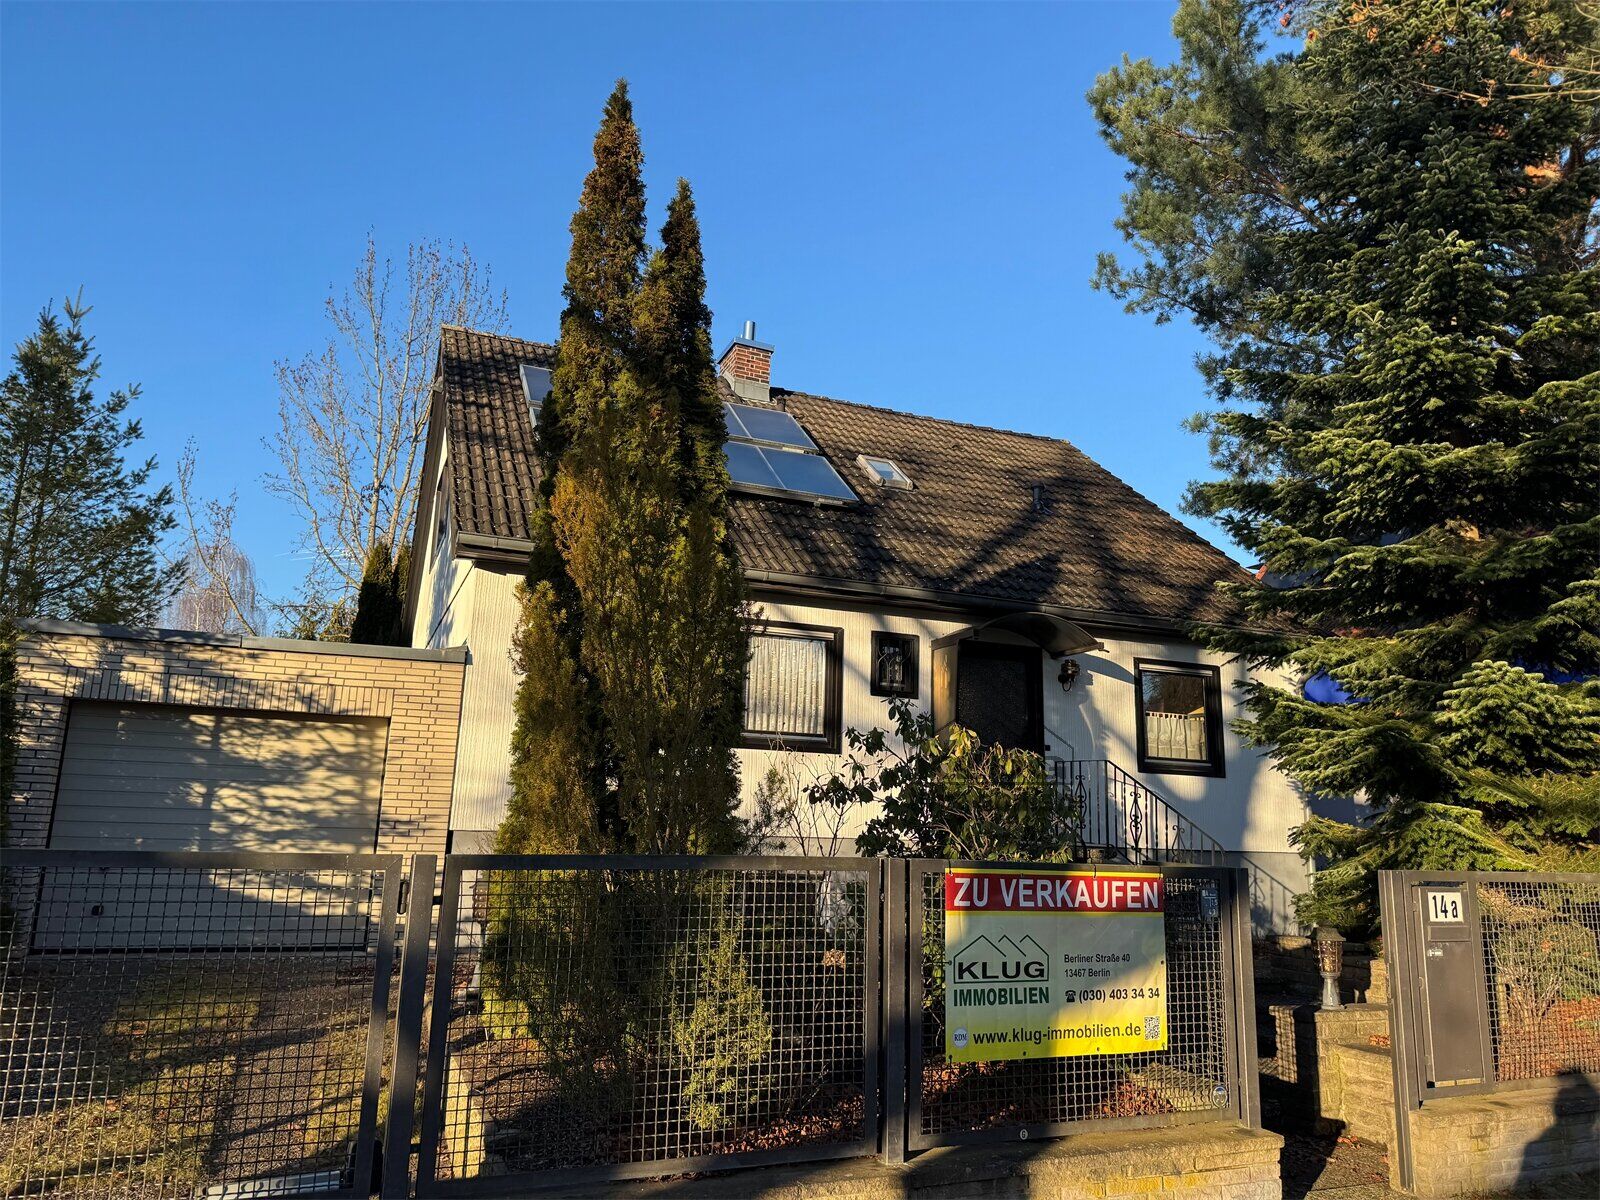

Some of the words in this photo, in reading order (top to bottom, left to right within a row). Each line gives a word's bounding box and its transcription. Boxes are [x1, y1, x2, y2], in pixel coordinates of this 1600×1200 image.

[953, 877, 989, 908] ZU
[999, 878, 1159, 909] VERKAUFEN
[1064, 954, 1094, 963] Berliner
[1095, 953, 1120, 963] Straße
[1121, 953, 1131, 962] 40
[957, 961, 1045, 980] KLUG
[1064, 968, 1086, 978] 13467
[1087, 968, 1111, 977] Berlin
[953, 986, 1050, 1007] IMMOBILIEN
[1078, 989, 1106, 1004] (030)
[1109, 988, 1128, 1000] 403
[1131, 988, 1145, 999] 34
[1148, 987, 1160, 999] 34
[973, 1022, 1141, 1045] www.klug-immobilien.de
